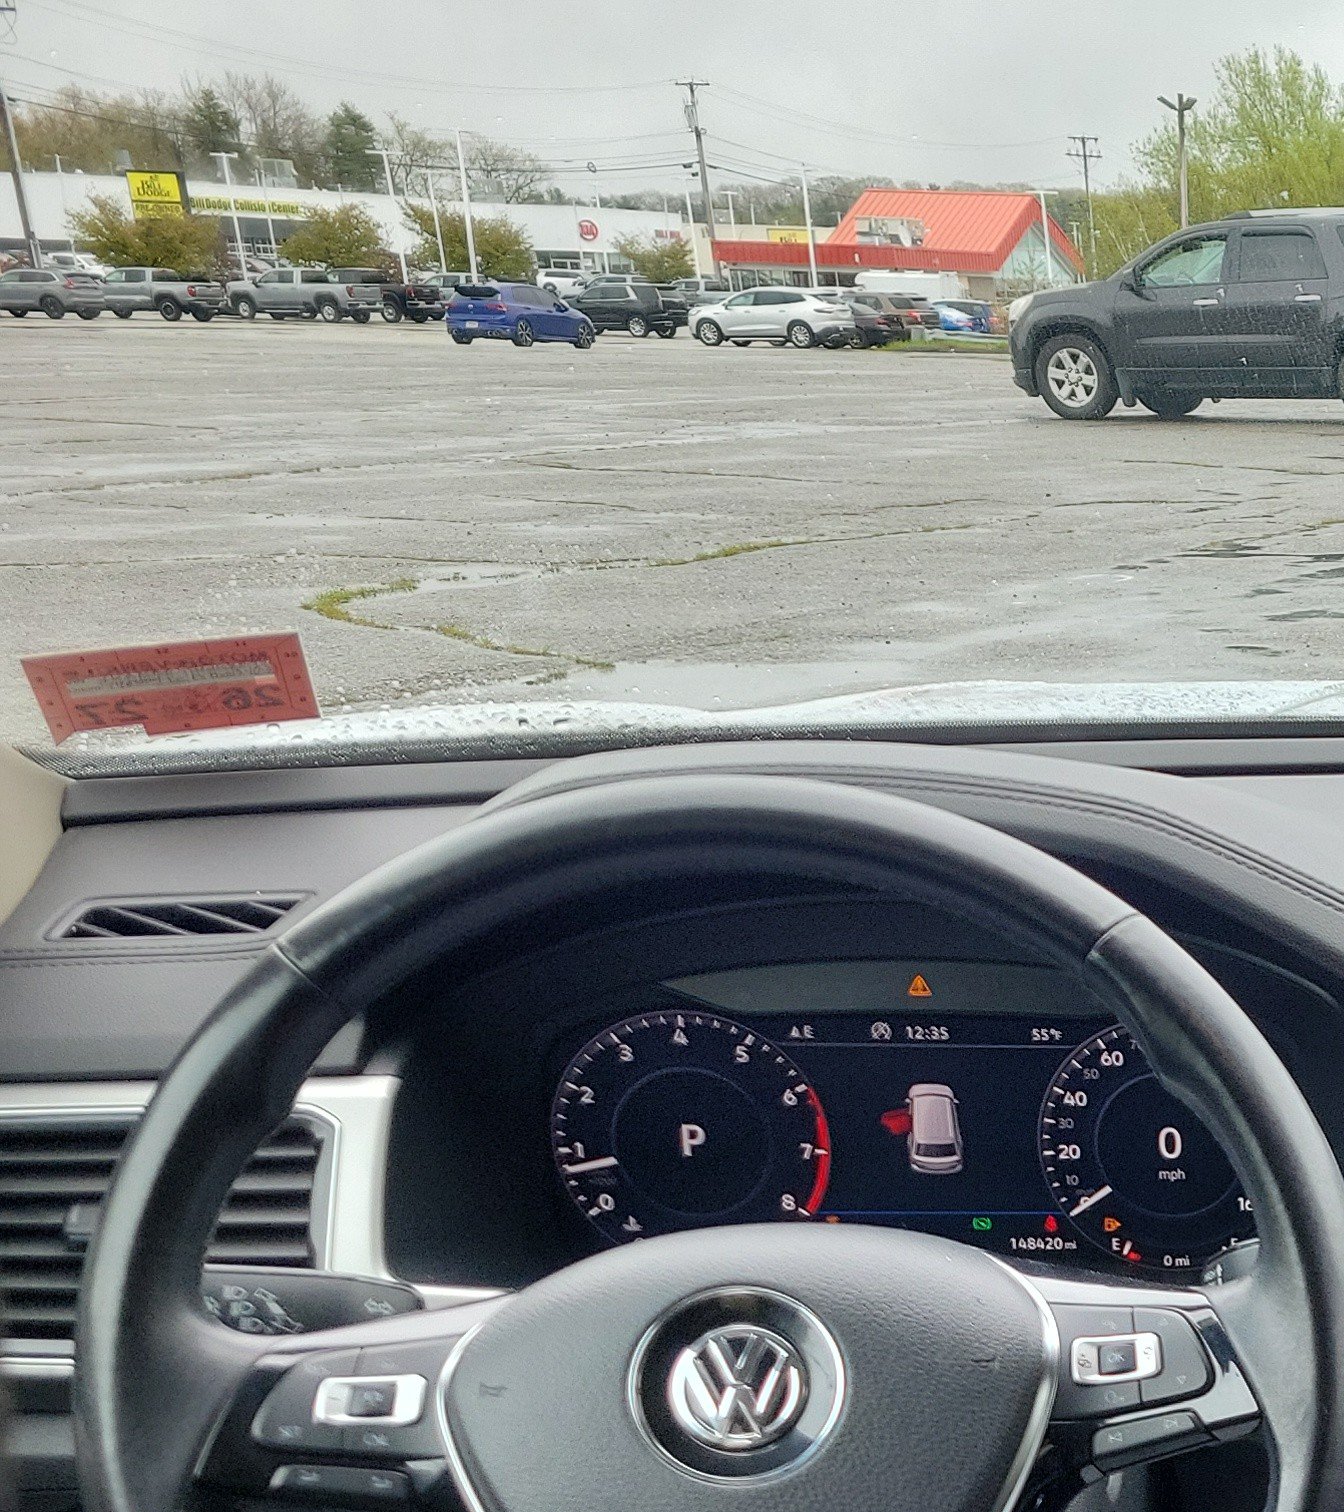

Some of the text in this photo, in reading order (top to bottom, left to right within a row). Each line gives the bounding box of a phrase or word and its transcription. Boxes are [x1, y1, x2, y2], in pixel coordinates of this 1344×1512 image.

[206, 198, 231, 211] Dodg
[271, 202, 299, 214] Center
[673, 1028, 689, 1046] 4
[905, 1025, 950, 1040] 12:35
[619, 1044, 634, 1062] 3
[735, 1044, 750, 1063] 5
[1100, 1051, 1124, 1067] 60
[1083, 1068, 1100, 1080] 50
[580, 1086, 596, 1104] 2
[783, 1089, 798, 1106] 6
[1063, 1090, 1088, 1107] 40
[1058, 1118, 1075, 1129] 30
[681, 1122, 707, 1157] P
[1158, 1126, 1183, 1160] 0
[575, 1141, 585, 1159] 1
[800, 1142, 813, 1160] 7
[1058, 1145, 1081, 1160] 20
[1066, 1174, 1079, 1185] 10
[1159, 1169, 1186, 1182] mph
[600, 1193, 616, 1211] 0
[781, 1193, 796, 1211] 8
[1010, 1237, 1077, 1250] 148420 mi
[1112, 1238, 1121, 1251] E
[1163, 1255, 1191, 1266] 0 mi
